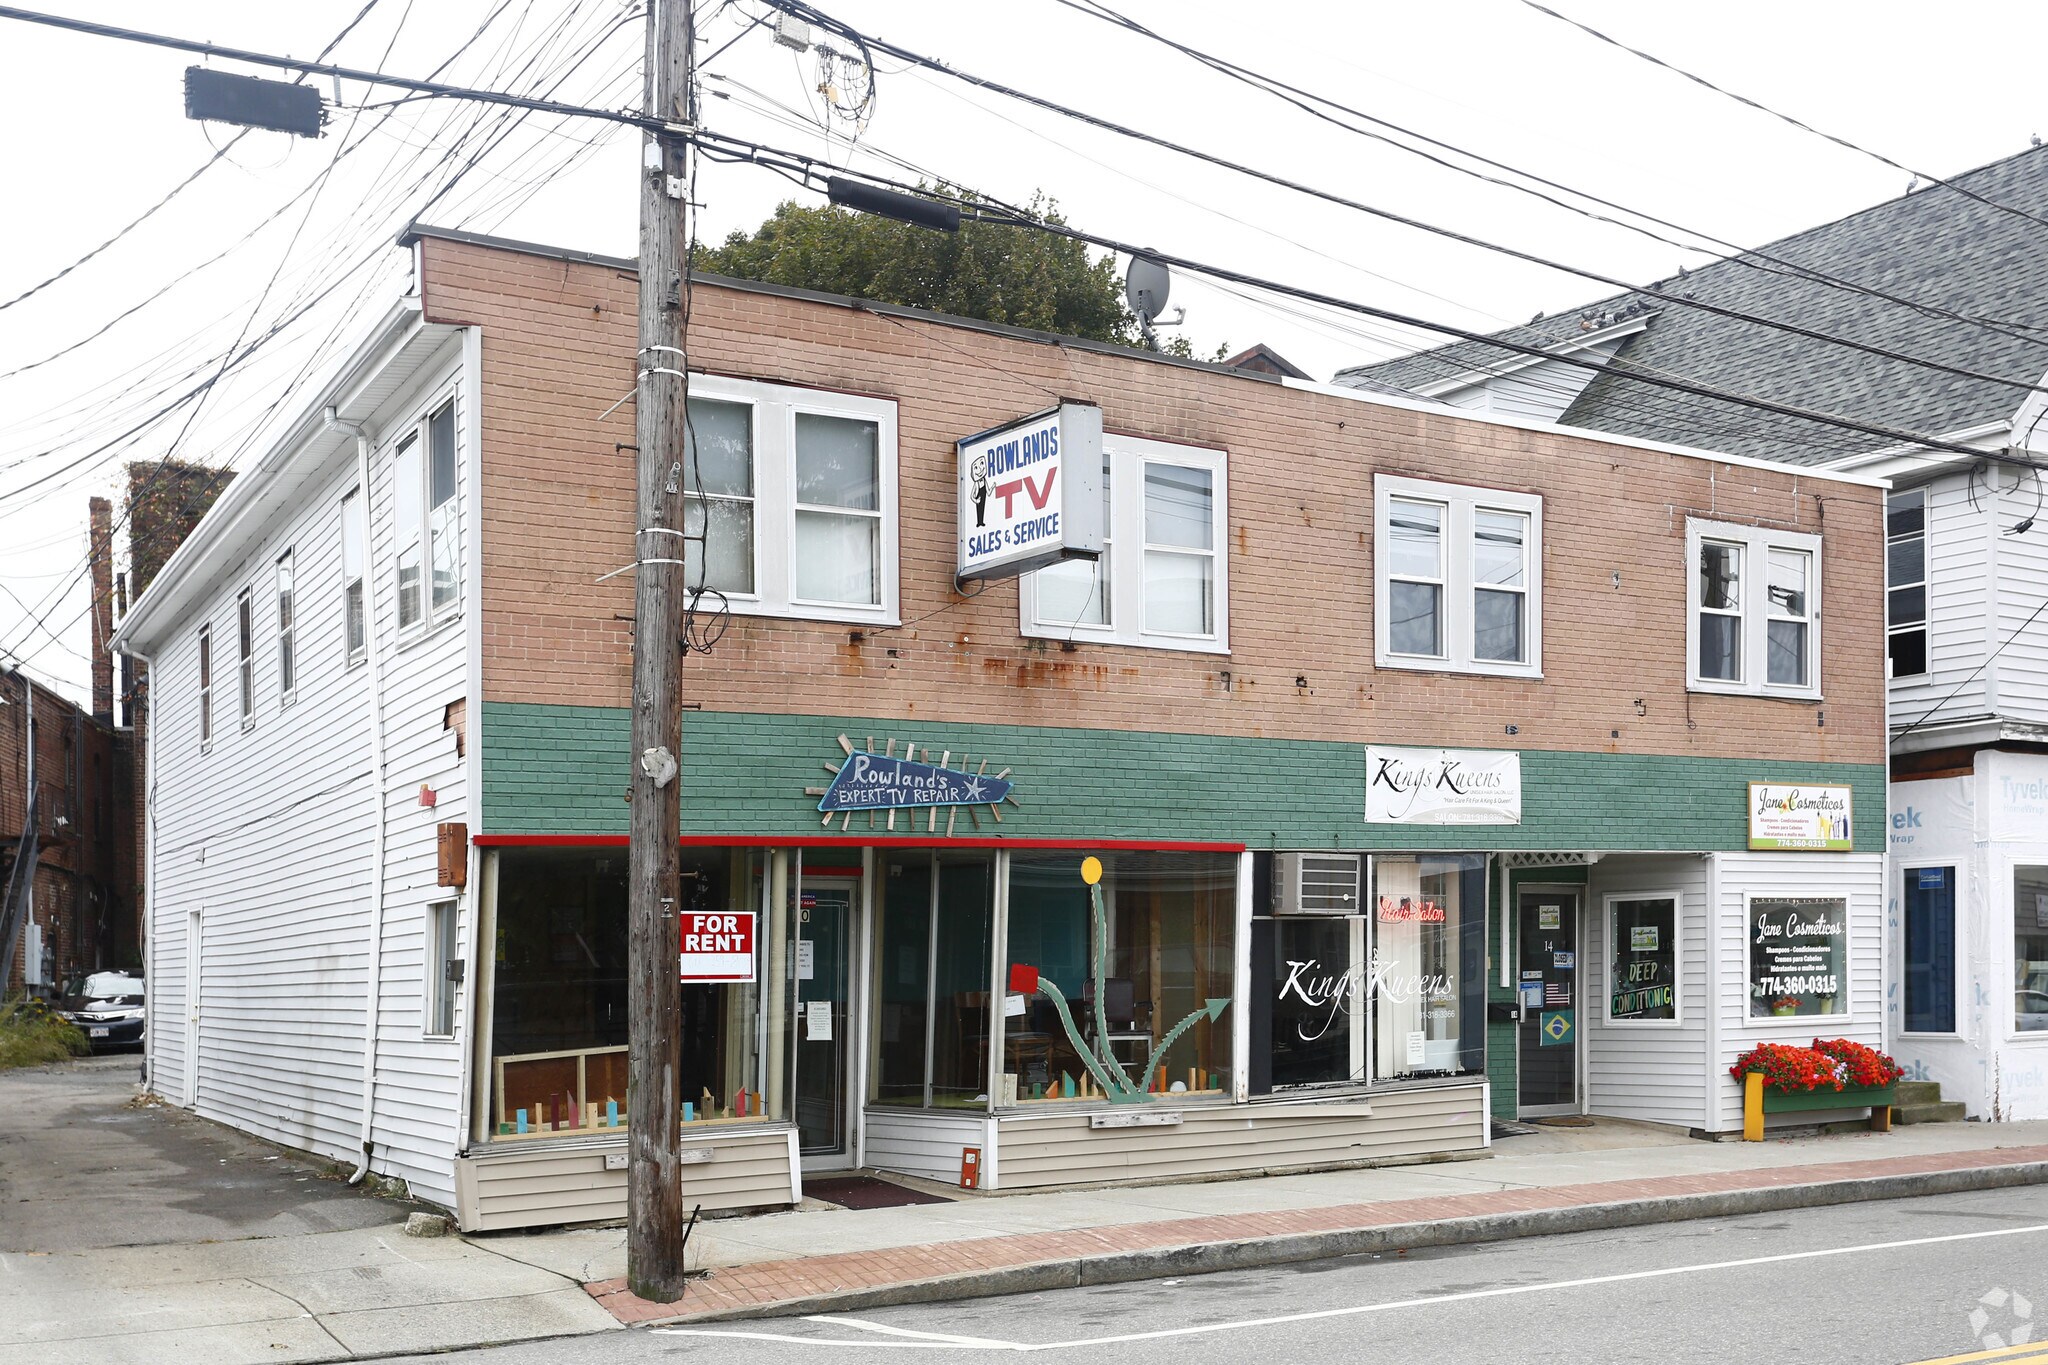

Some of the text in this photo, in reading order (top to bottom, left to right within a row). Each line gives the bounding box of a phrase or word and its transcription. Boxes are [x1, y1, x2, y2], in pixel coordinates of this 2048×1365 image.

[987, 426, 1058, 478] ROWLANDS
[995, 466, 1058, 519] TV
[968, 512, 1059, 557] SALES & SERVICE
[848, 755, 948, 789] Rowland's
[839, 788, 960, 804] EXPERT TV REPAIR
[1372, 757, 1502, 819] Kings Kueens
[2000, 775, 2048, 802] Tyvek
[1758, 788, 1783, 815] Jane
[1777, 839, 1827, 848] 774-360-0315
[664, 904, 670, 912] 2
[1379, 896, 1446, 922] Hair Salon
[693, 916, 738, 933] FOR
[1756, 913, 1782, 944] Jane
[685, 934, 745, 952] RENT
[1544, 940, 1553, 953] 14
[1629, 961, 1658, 982] DEEP
[1760, 974, 1837, 996] 774-360-0315
[1278, 959, 1360, 1042] Kings
[1367, 960, 1454, 1005] Kueens
